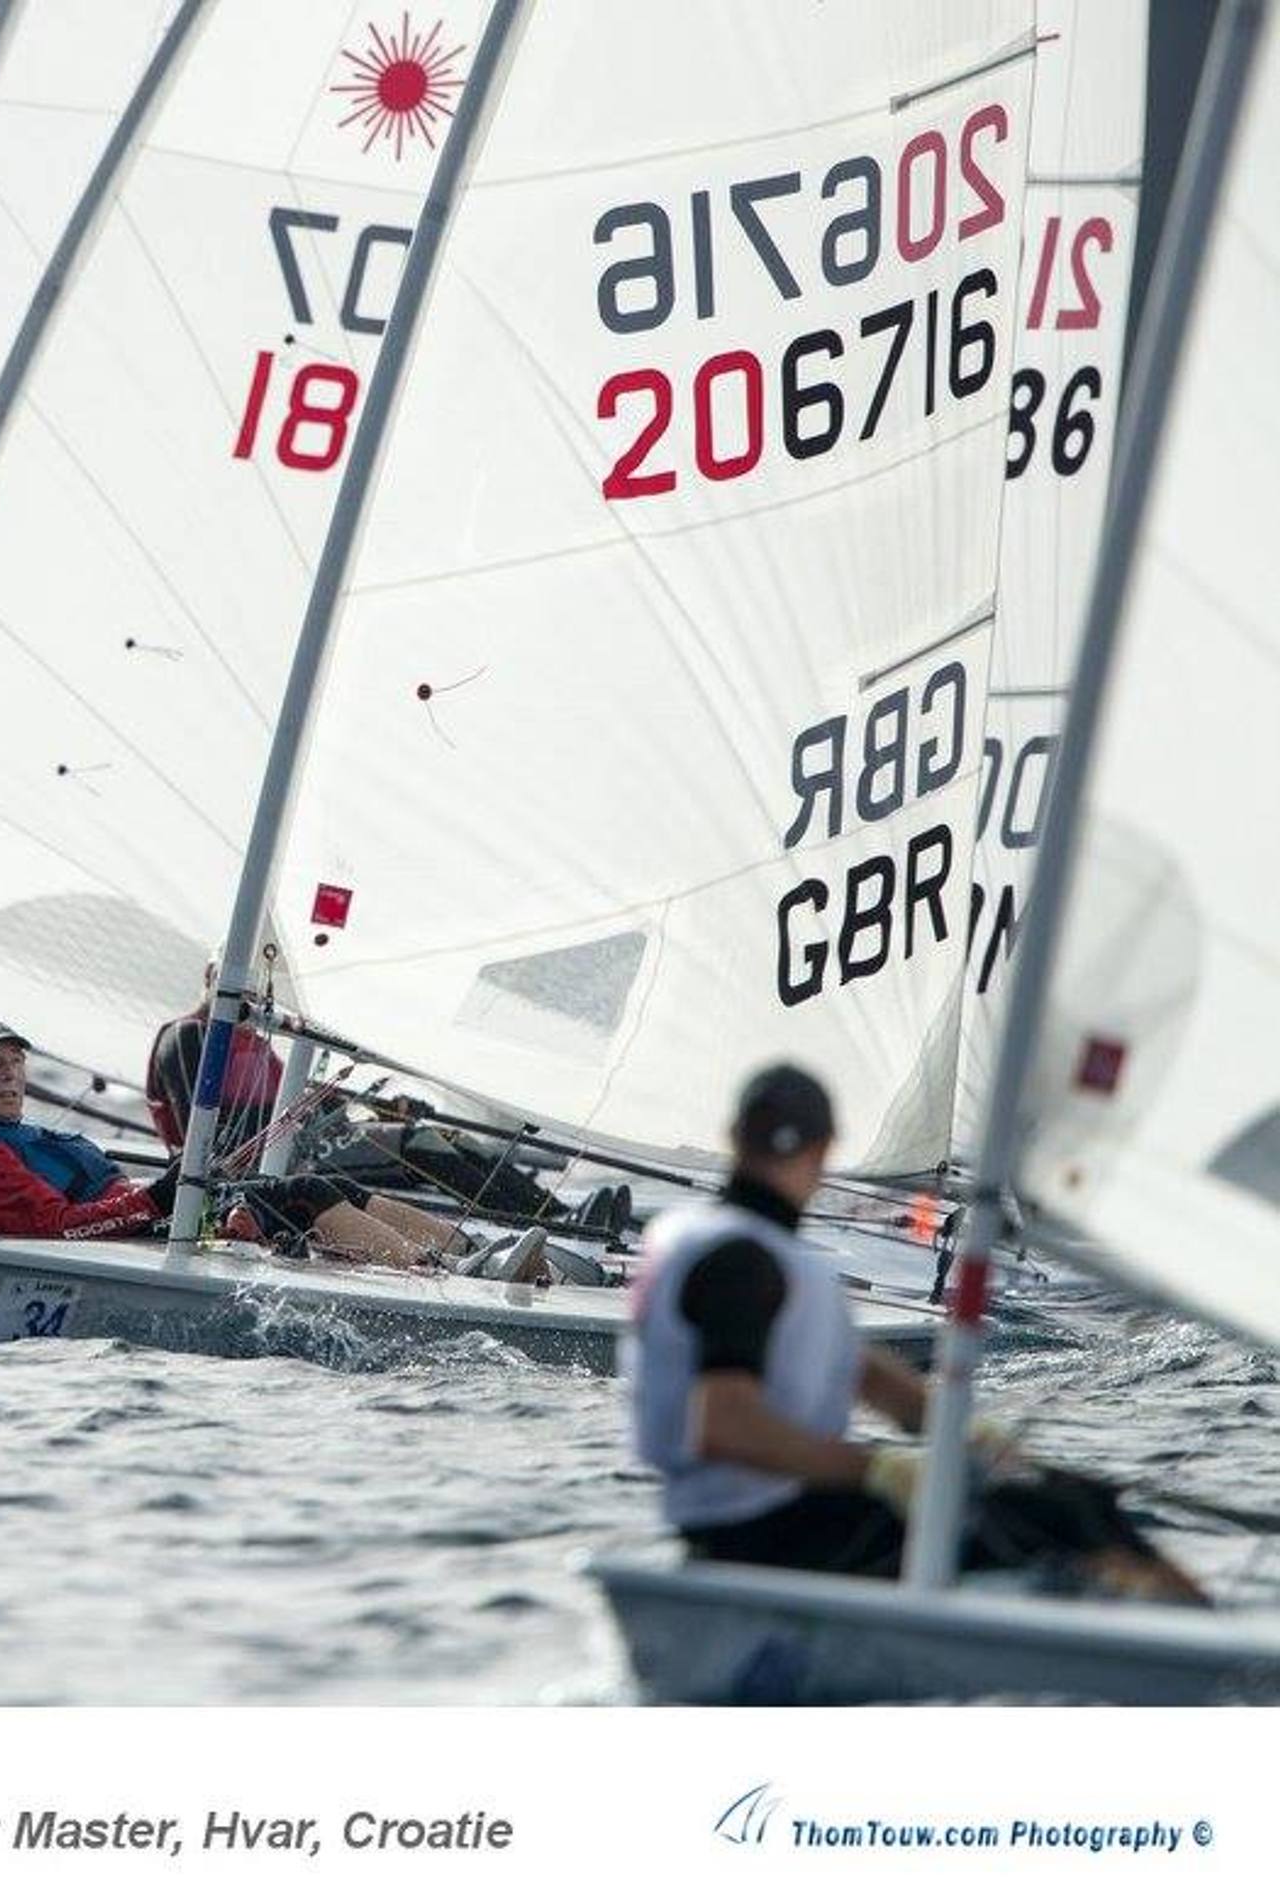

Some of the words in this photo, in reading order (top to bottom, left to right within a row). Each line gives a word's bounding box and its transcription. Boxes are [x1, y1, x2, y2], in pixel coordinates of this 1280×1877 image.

[233, 350, 360, 472] 18
[597, 268, 998, 502] 206716
[778, 824, 952, 1008] GBR
[24, 1300, 69, 1337] 34
